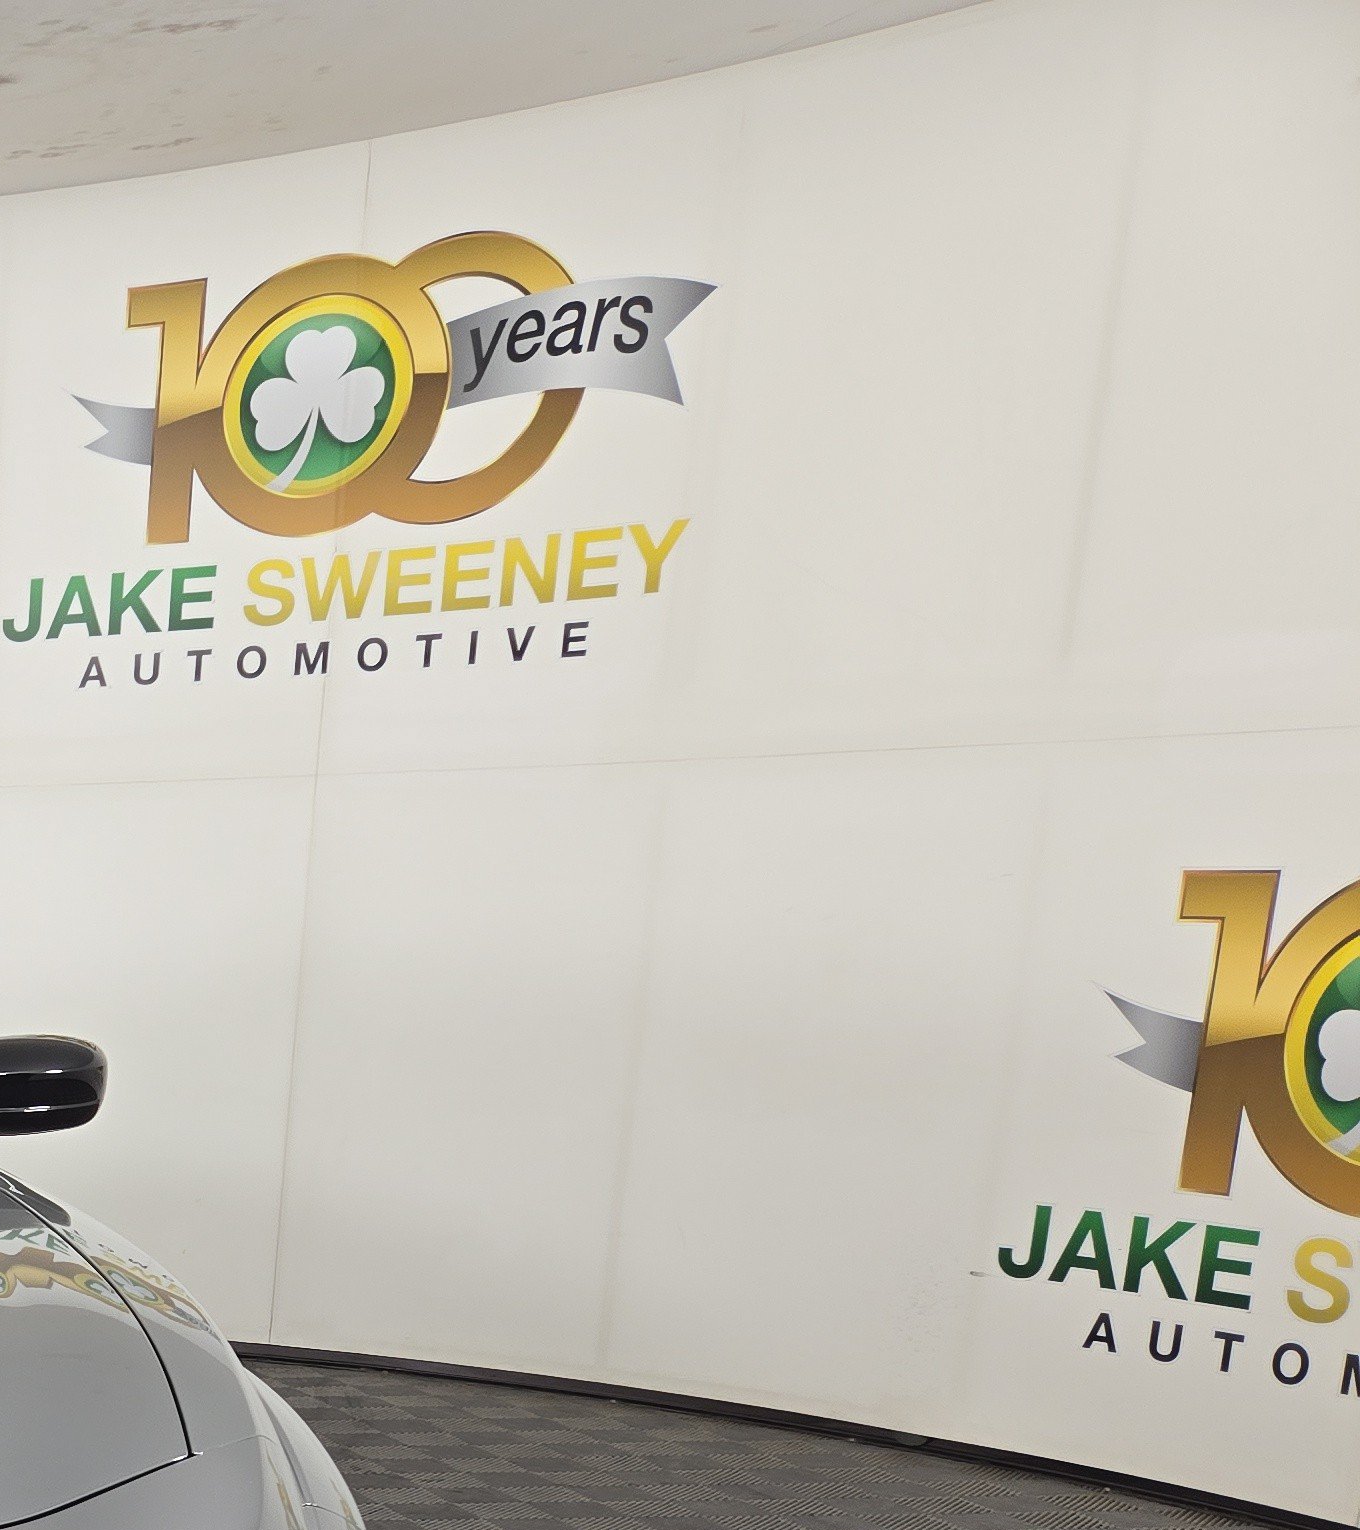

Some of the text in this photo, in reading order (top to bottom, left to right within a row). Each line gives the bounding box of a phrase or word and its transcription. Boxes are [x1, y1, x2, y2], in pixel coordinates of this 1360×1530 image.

[126, 230, 655, 546] 100 years
[1, 518, 691, 643] JAKE SWEENEY
[78, 621, 590, 690] AUTOMOTIVE
[997, 1204, 1262, 1312] JAKE
